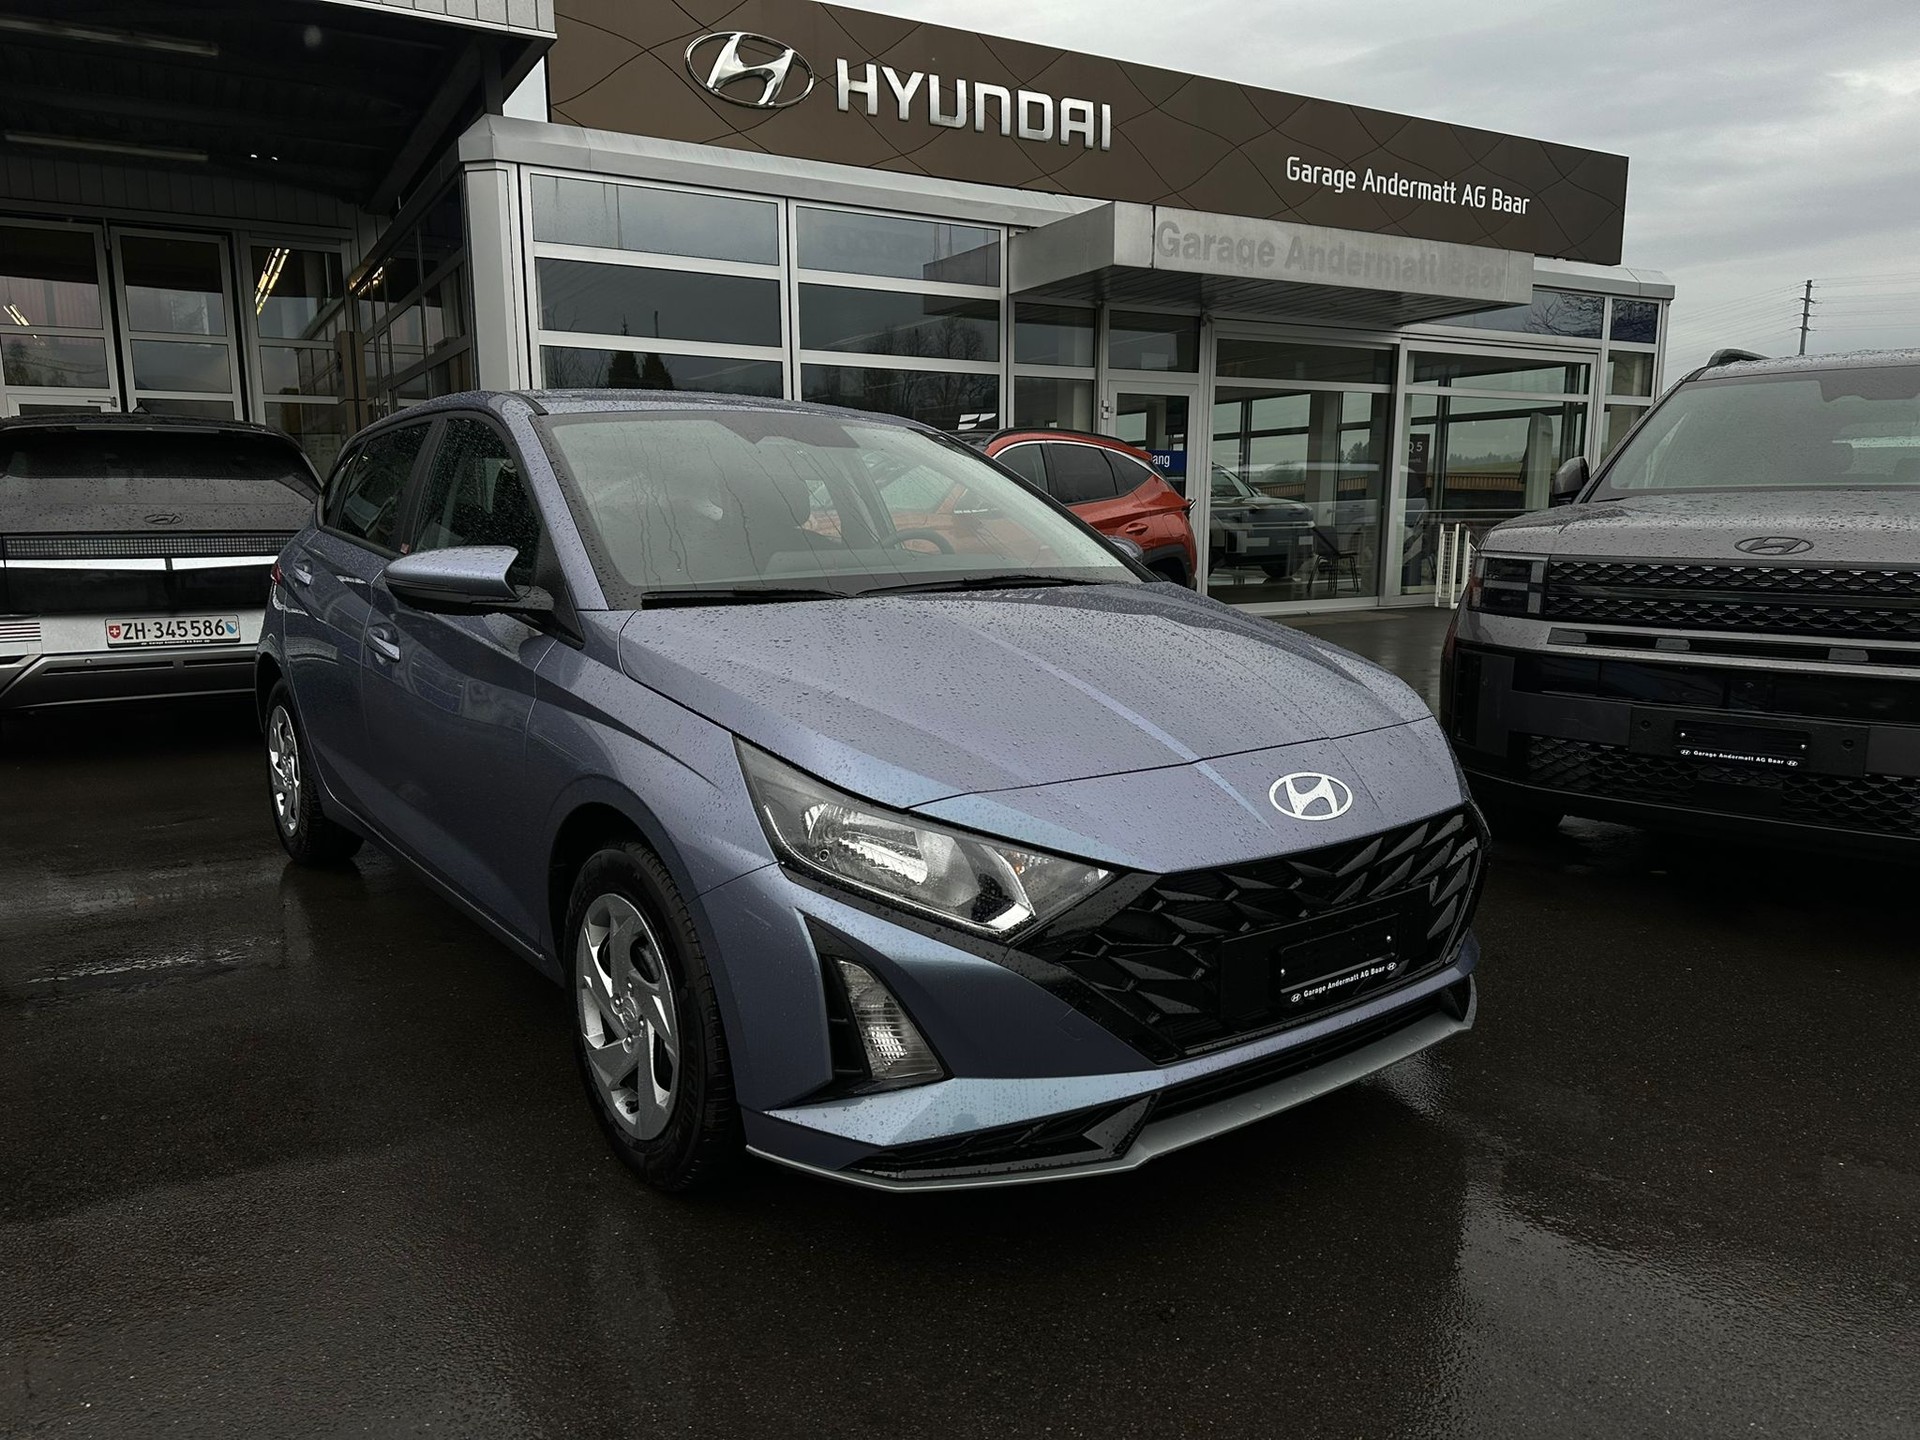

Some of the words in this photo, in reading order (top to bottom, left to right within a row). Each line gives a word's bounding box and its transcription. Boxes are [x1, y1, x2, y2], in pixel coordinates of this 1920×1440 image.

[836, 58, 1113, 151] HYUNDAI
[1286, 156, 1356, 194] Garage
[1361, 168, 1457, 205] Andermatt
[1460, 183, 1487, 209] AG
[1491, 187, 1531, 215] Baar
[1156, 220, 1276, 269] Garage
[1284, 235, 1437, 286] Andermatt
[1693, 750, 1717, 758] Garage
[1303, 985, 1326, 998] Garage
[1327, 973, 1359, 990] Andermatt
[1359, 969, 1370, 979] AG
[1370, 965, 1385, 976] Baar
